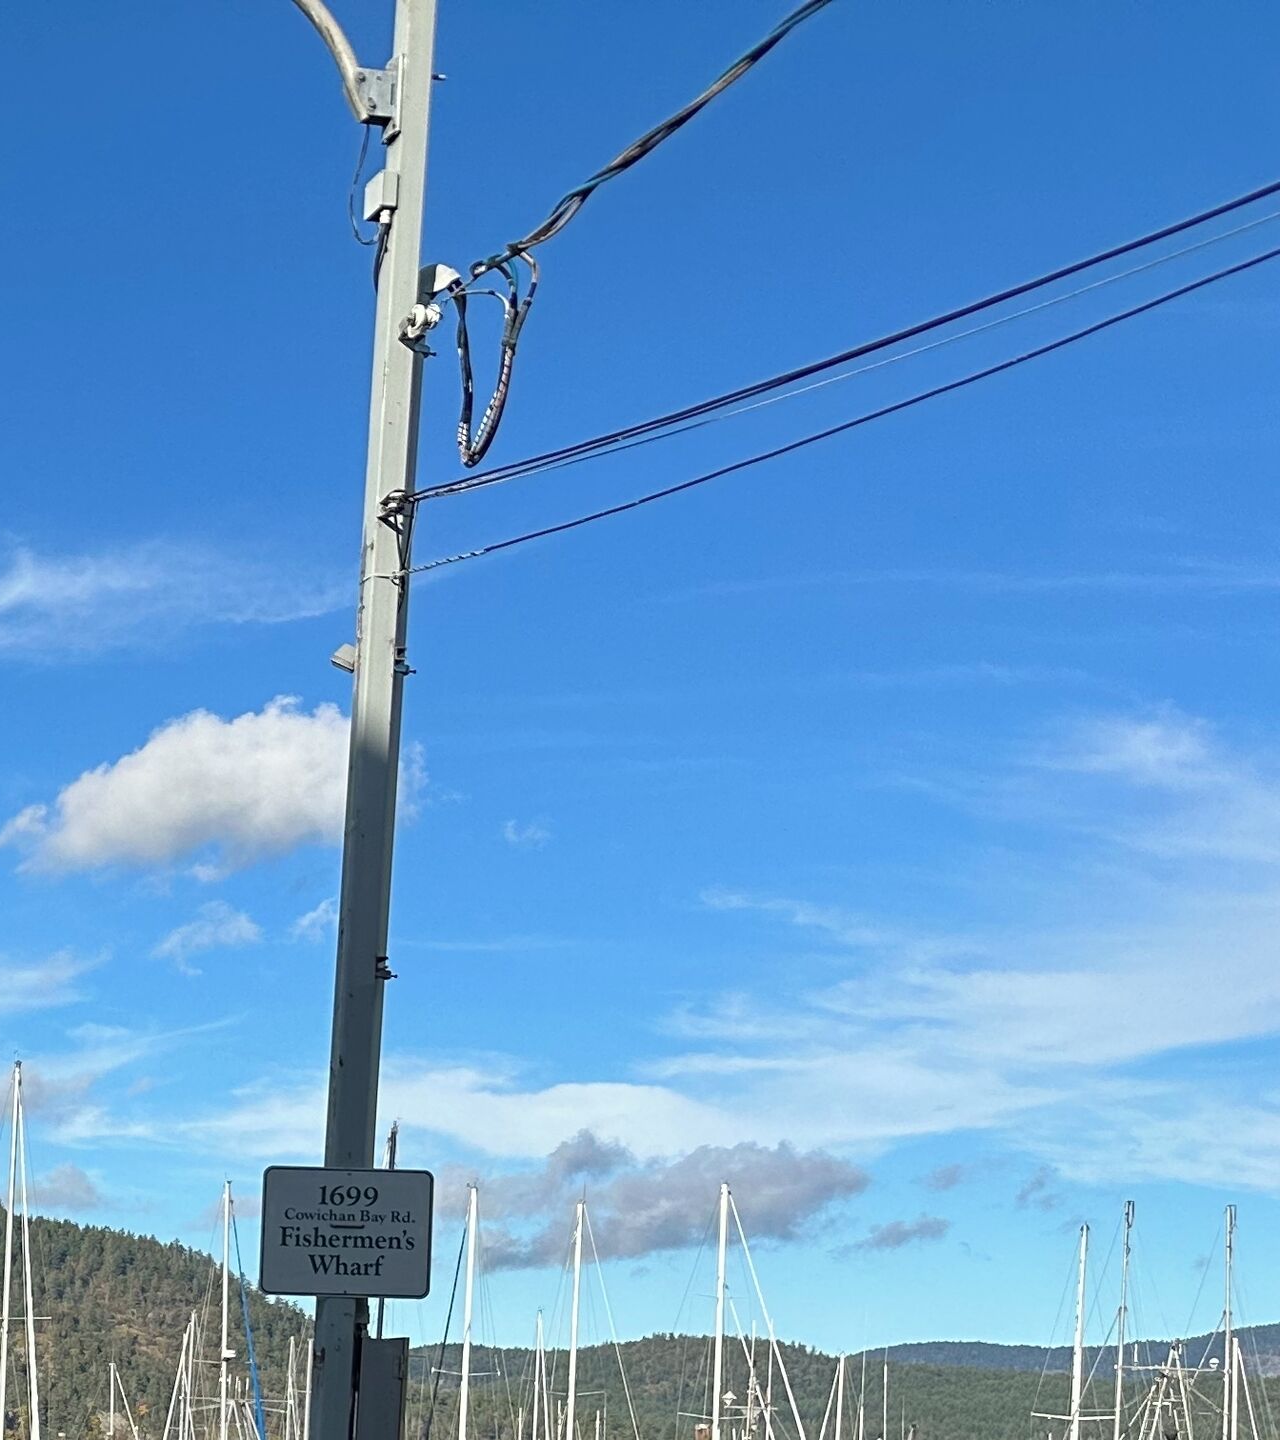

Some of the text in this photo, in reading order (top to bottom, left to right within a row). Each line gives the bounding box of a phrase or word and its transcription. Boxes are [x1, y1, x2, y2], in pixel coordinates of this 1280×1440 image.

[318, 1185, 379, 1207] 1699
[284, 1207, 416, 1225] Cowichan Bay Rd.
[279, 1226, 416, 1250] Fishermen's
[308, 1254, 385, 1276] Wharf
